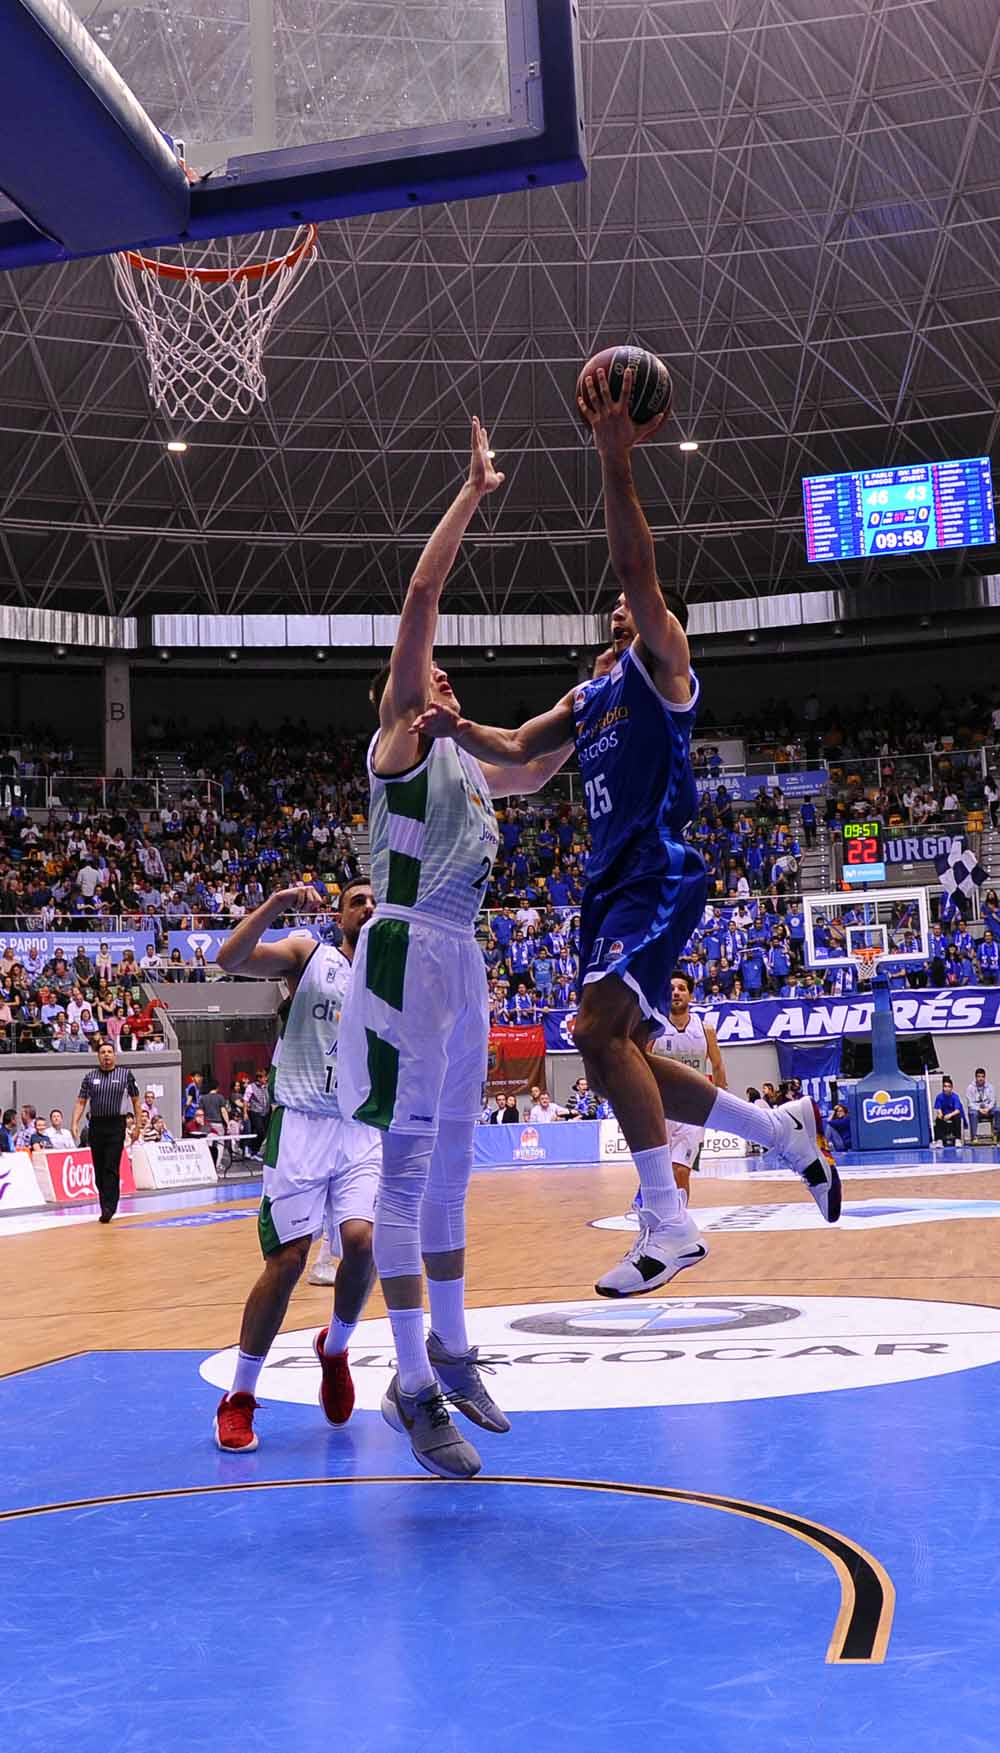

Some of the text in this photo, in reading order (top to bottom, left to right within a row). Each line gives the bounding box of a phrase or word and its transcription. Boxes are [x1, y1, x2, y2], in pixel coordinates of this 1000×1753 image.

[867, 489, 889, 506] 46
[905, 485, 927, 502] 43
[870, 512, 881, 525] 0
[918, 507, 929, 520] 0
[875, 529, 925, 549] 09:58
[111, 702, 125, 720] B
[585, 773, 613, 819] 25
[844, 823, 879, 838] 09:57
[848, 839, 878, 864] 22
[10, 937, 48, 952] PARDO
[767, 990, 985, 1038] ANDRÉS
